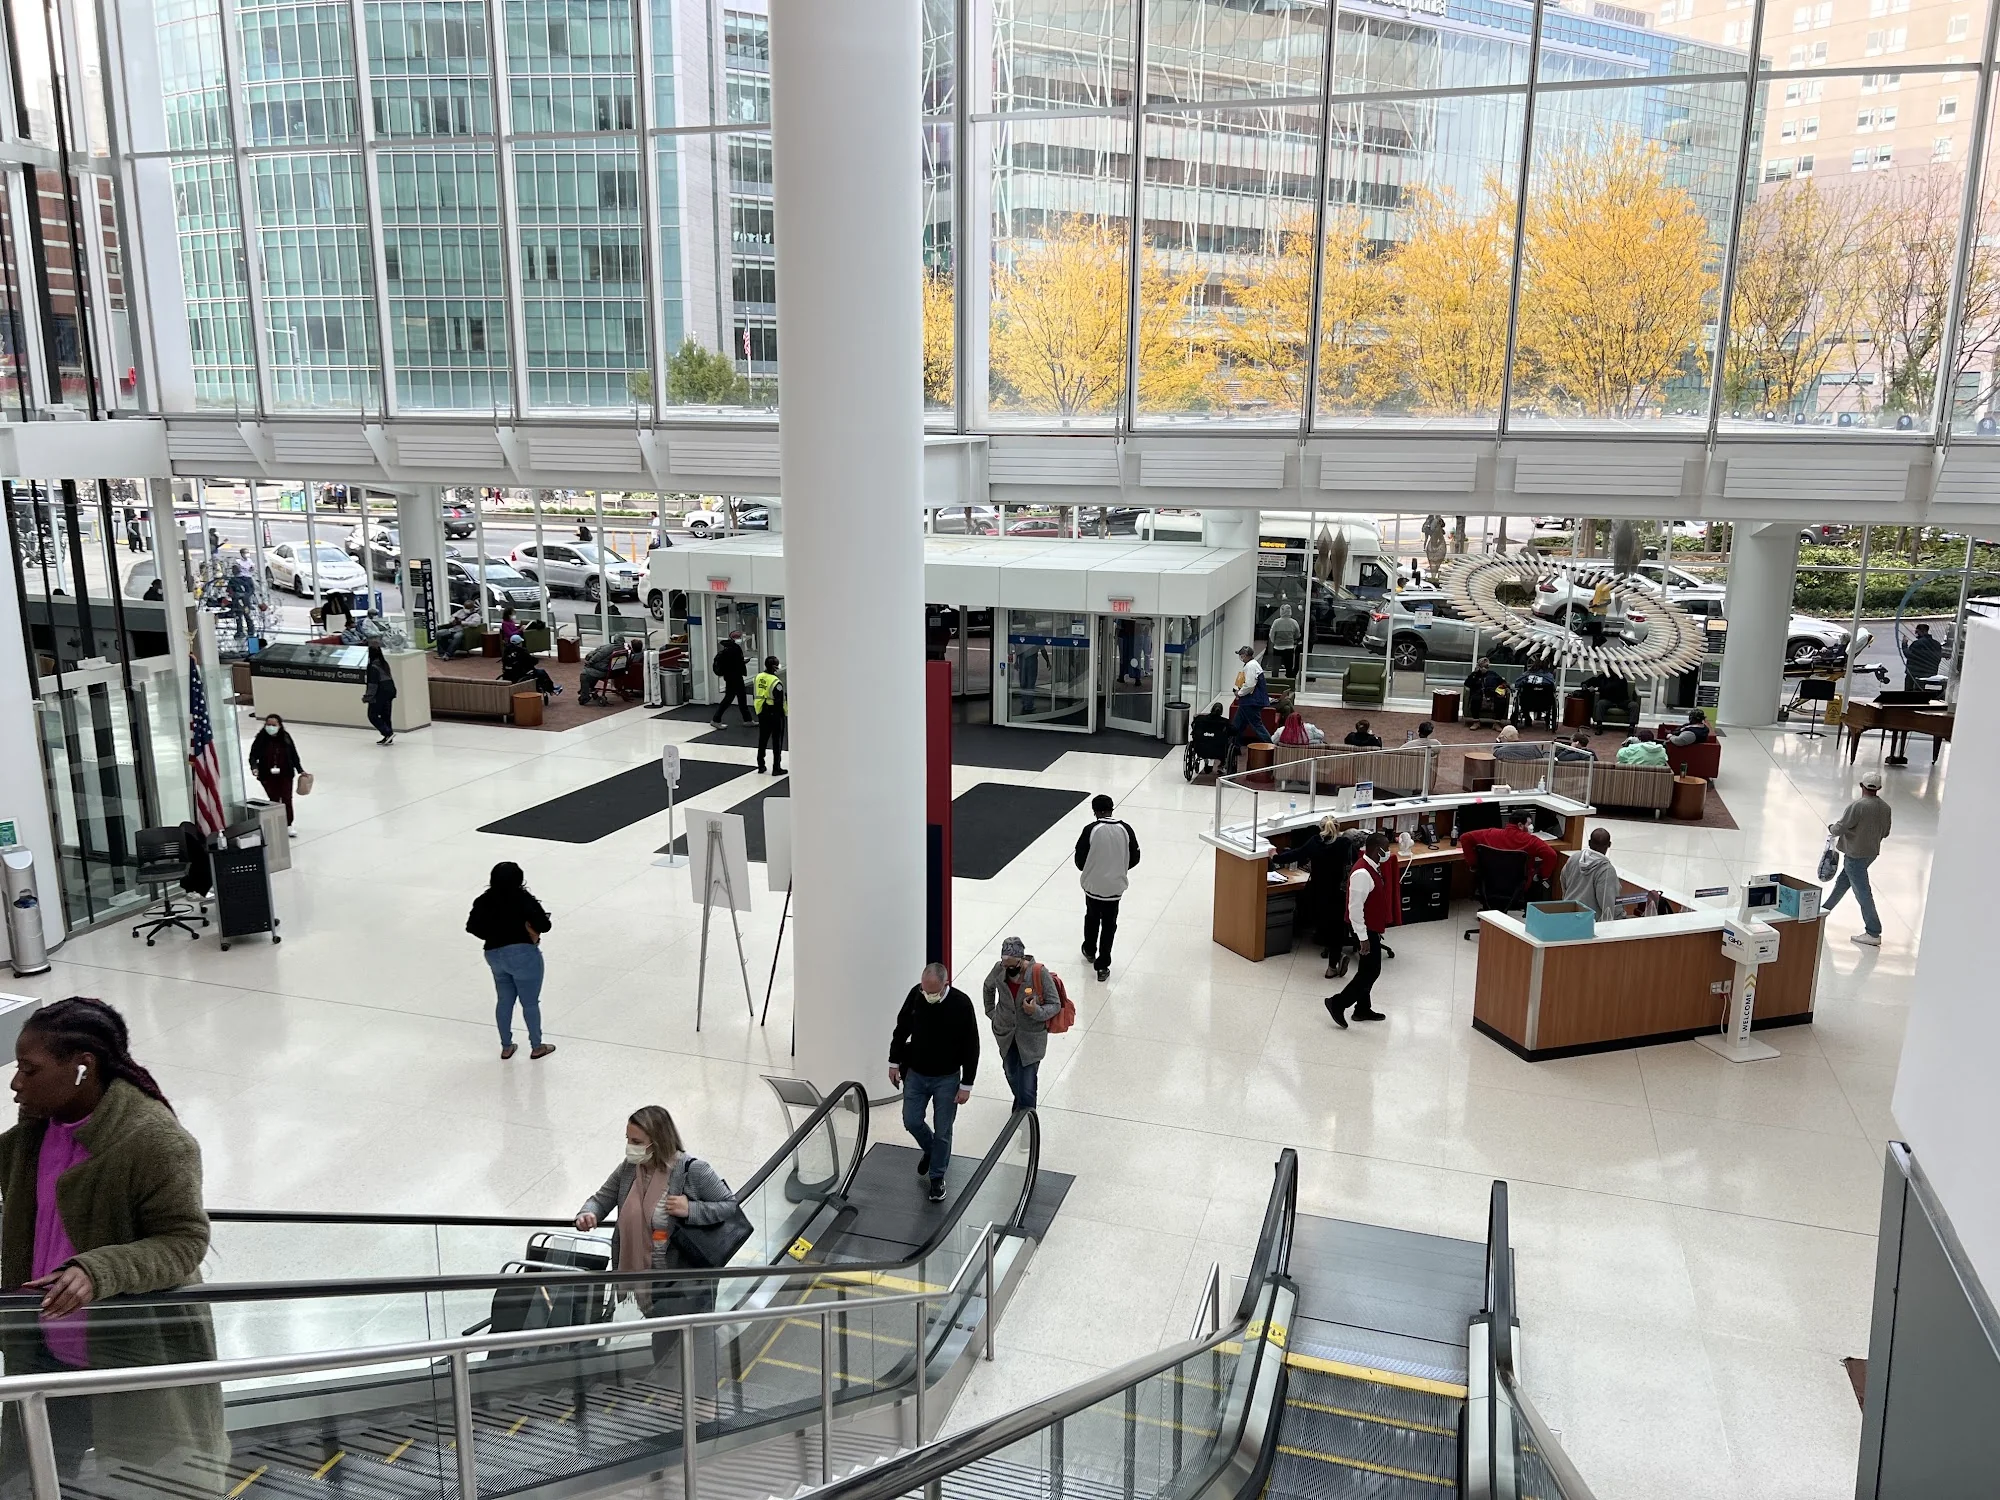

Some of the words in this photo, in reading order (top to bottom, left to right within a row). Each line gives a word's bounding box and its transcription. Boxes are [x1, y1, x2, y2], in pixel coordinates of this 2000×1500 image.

[1112, 601, 1129, 611] EXIT
[286, 667, 307, 675] Proton
[308, 669, 336, 679] Therapy
[337, 671, 360, 679] Center
[1741, 993, 1752, 1032] WELCOME
